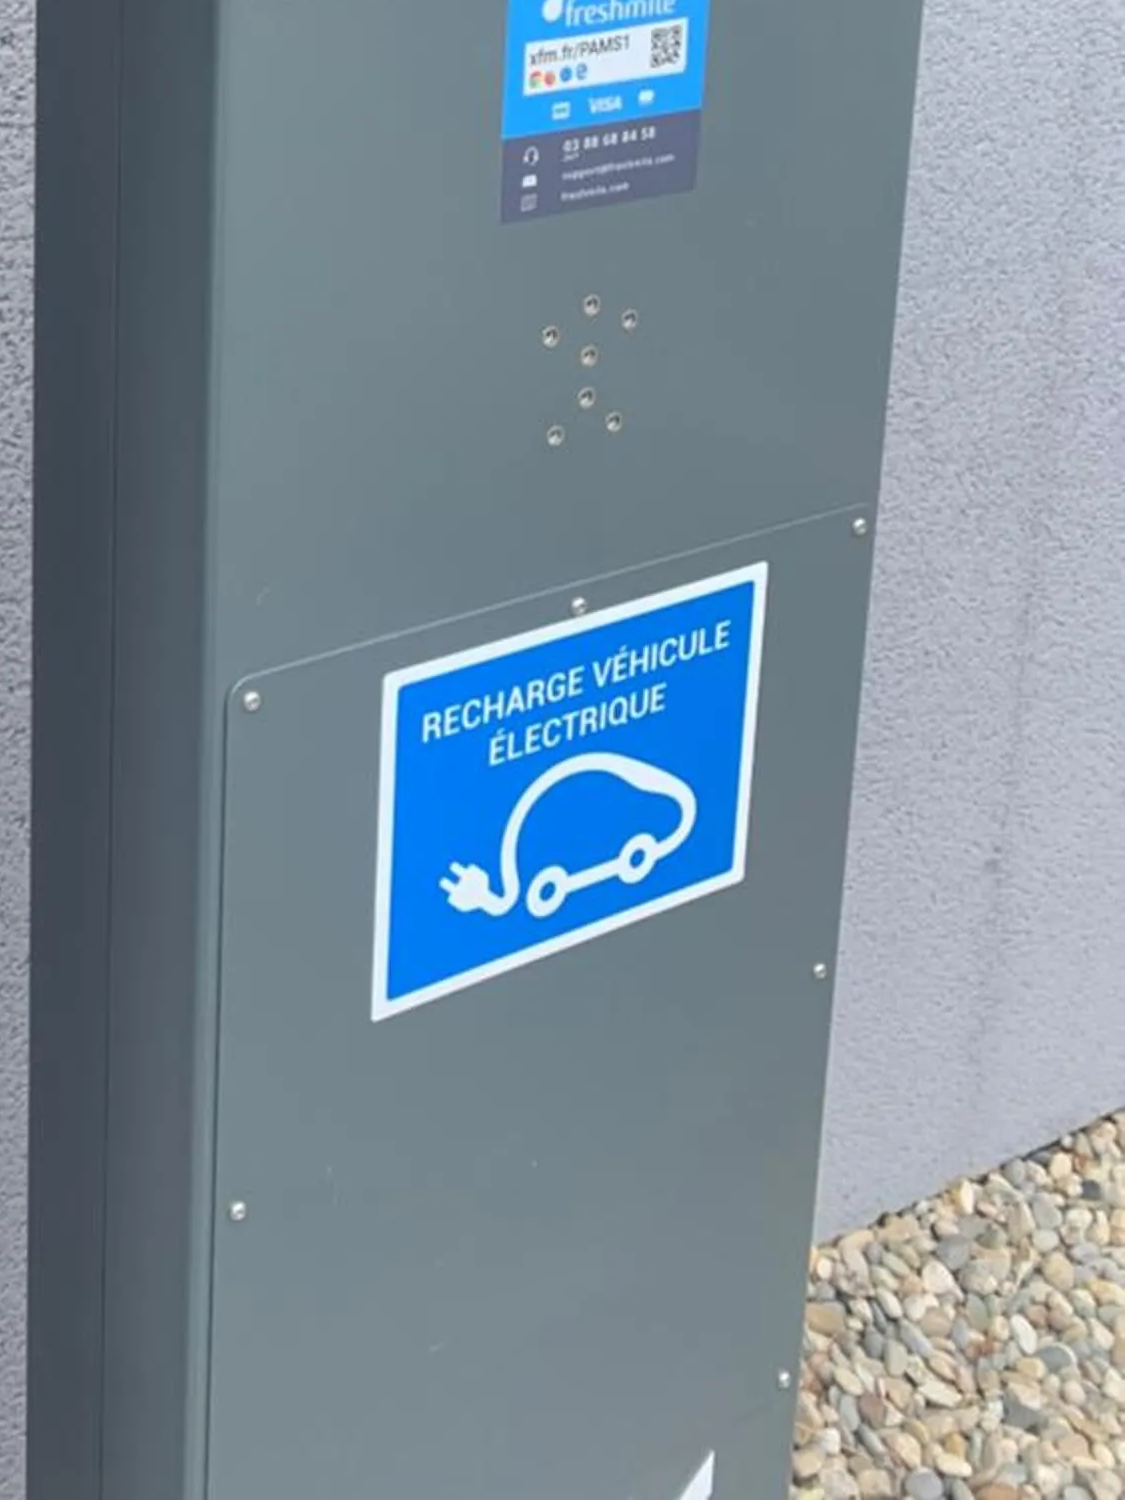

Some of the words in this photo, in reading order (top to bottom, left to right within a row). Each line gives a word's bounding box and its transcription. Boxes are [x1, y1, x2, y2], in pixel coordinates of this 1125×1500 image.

[421, 665, 586, 744] RECHARGE
[592, 619, 733, 689] VÉHICULE
[488, 682, 668, 767] ÉLECTRIQUE
